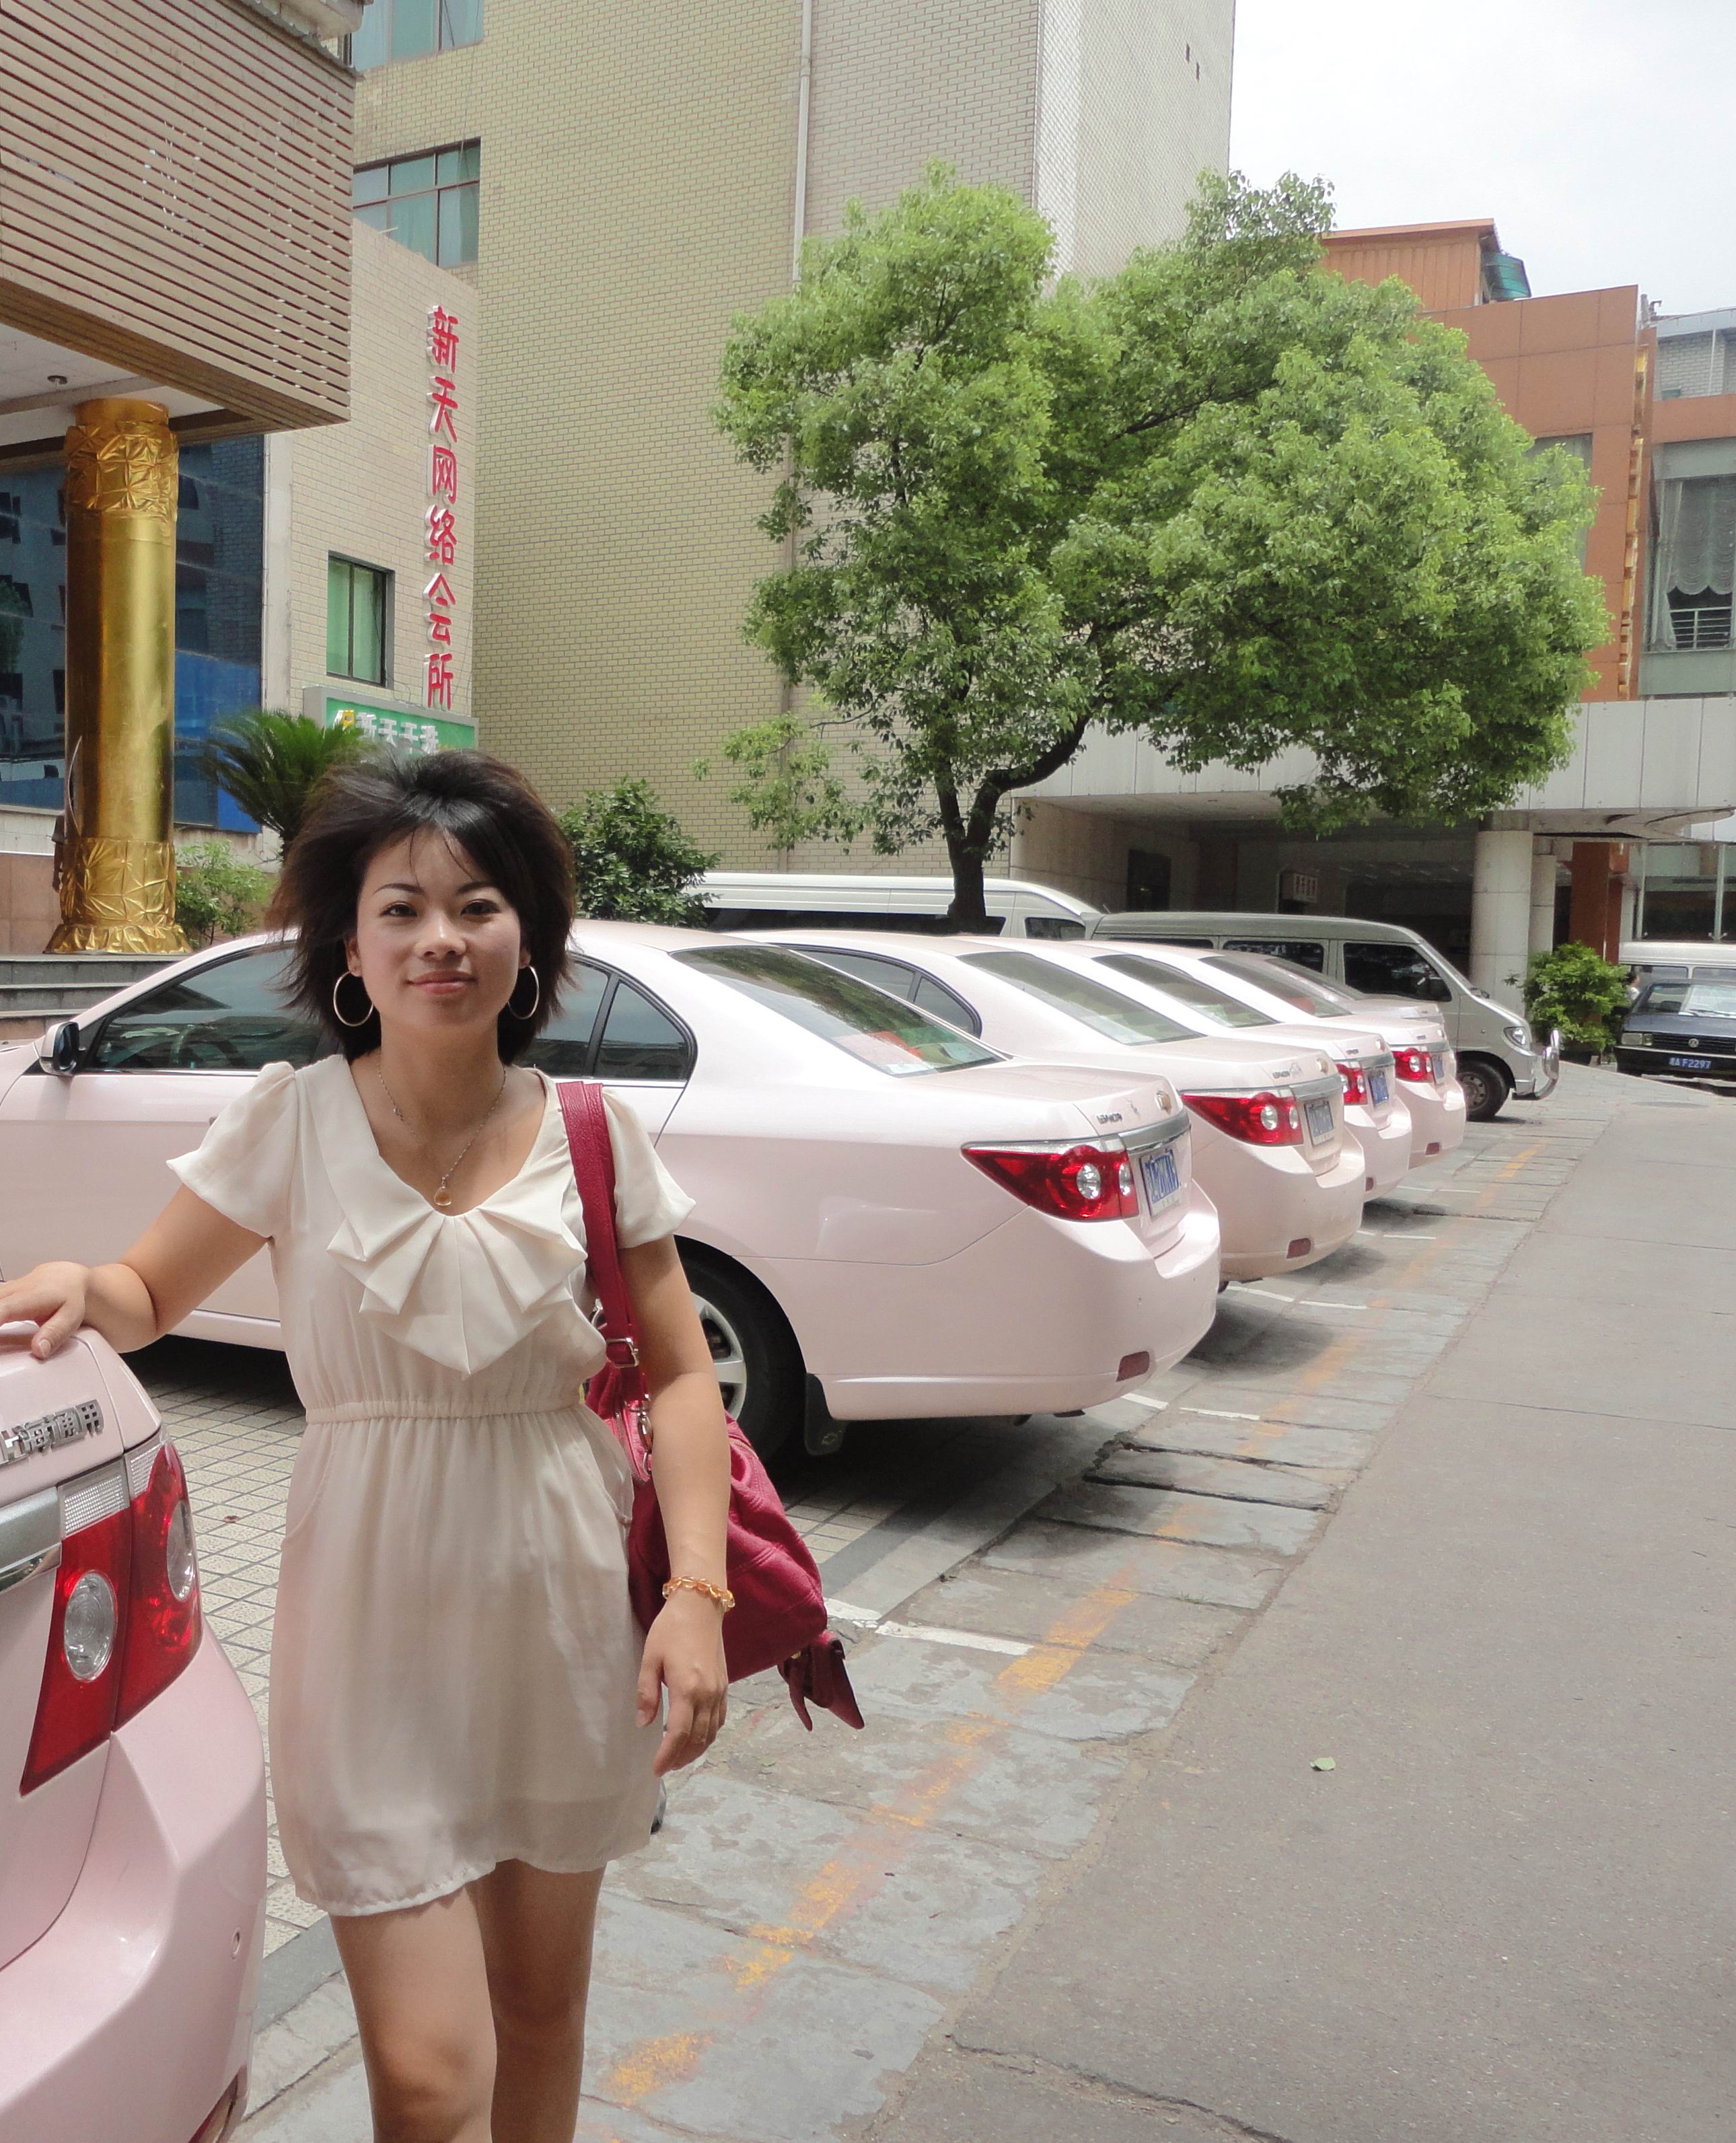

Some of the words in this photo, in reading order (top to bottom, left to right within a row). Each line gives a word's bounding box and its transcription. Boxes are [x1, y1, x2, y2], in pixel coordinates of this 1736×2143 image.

[424, 305, 459, 711] 新天网络会所
